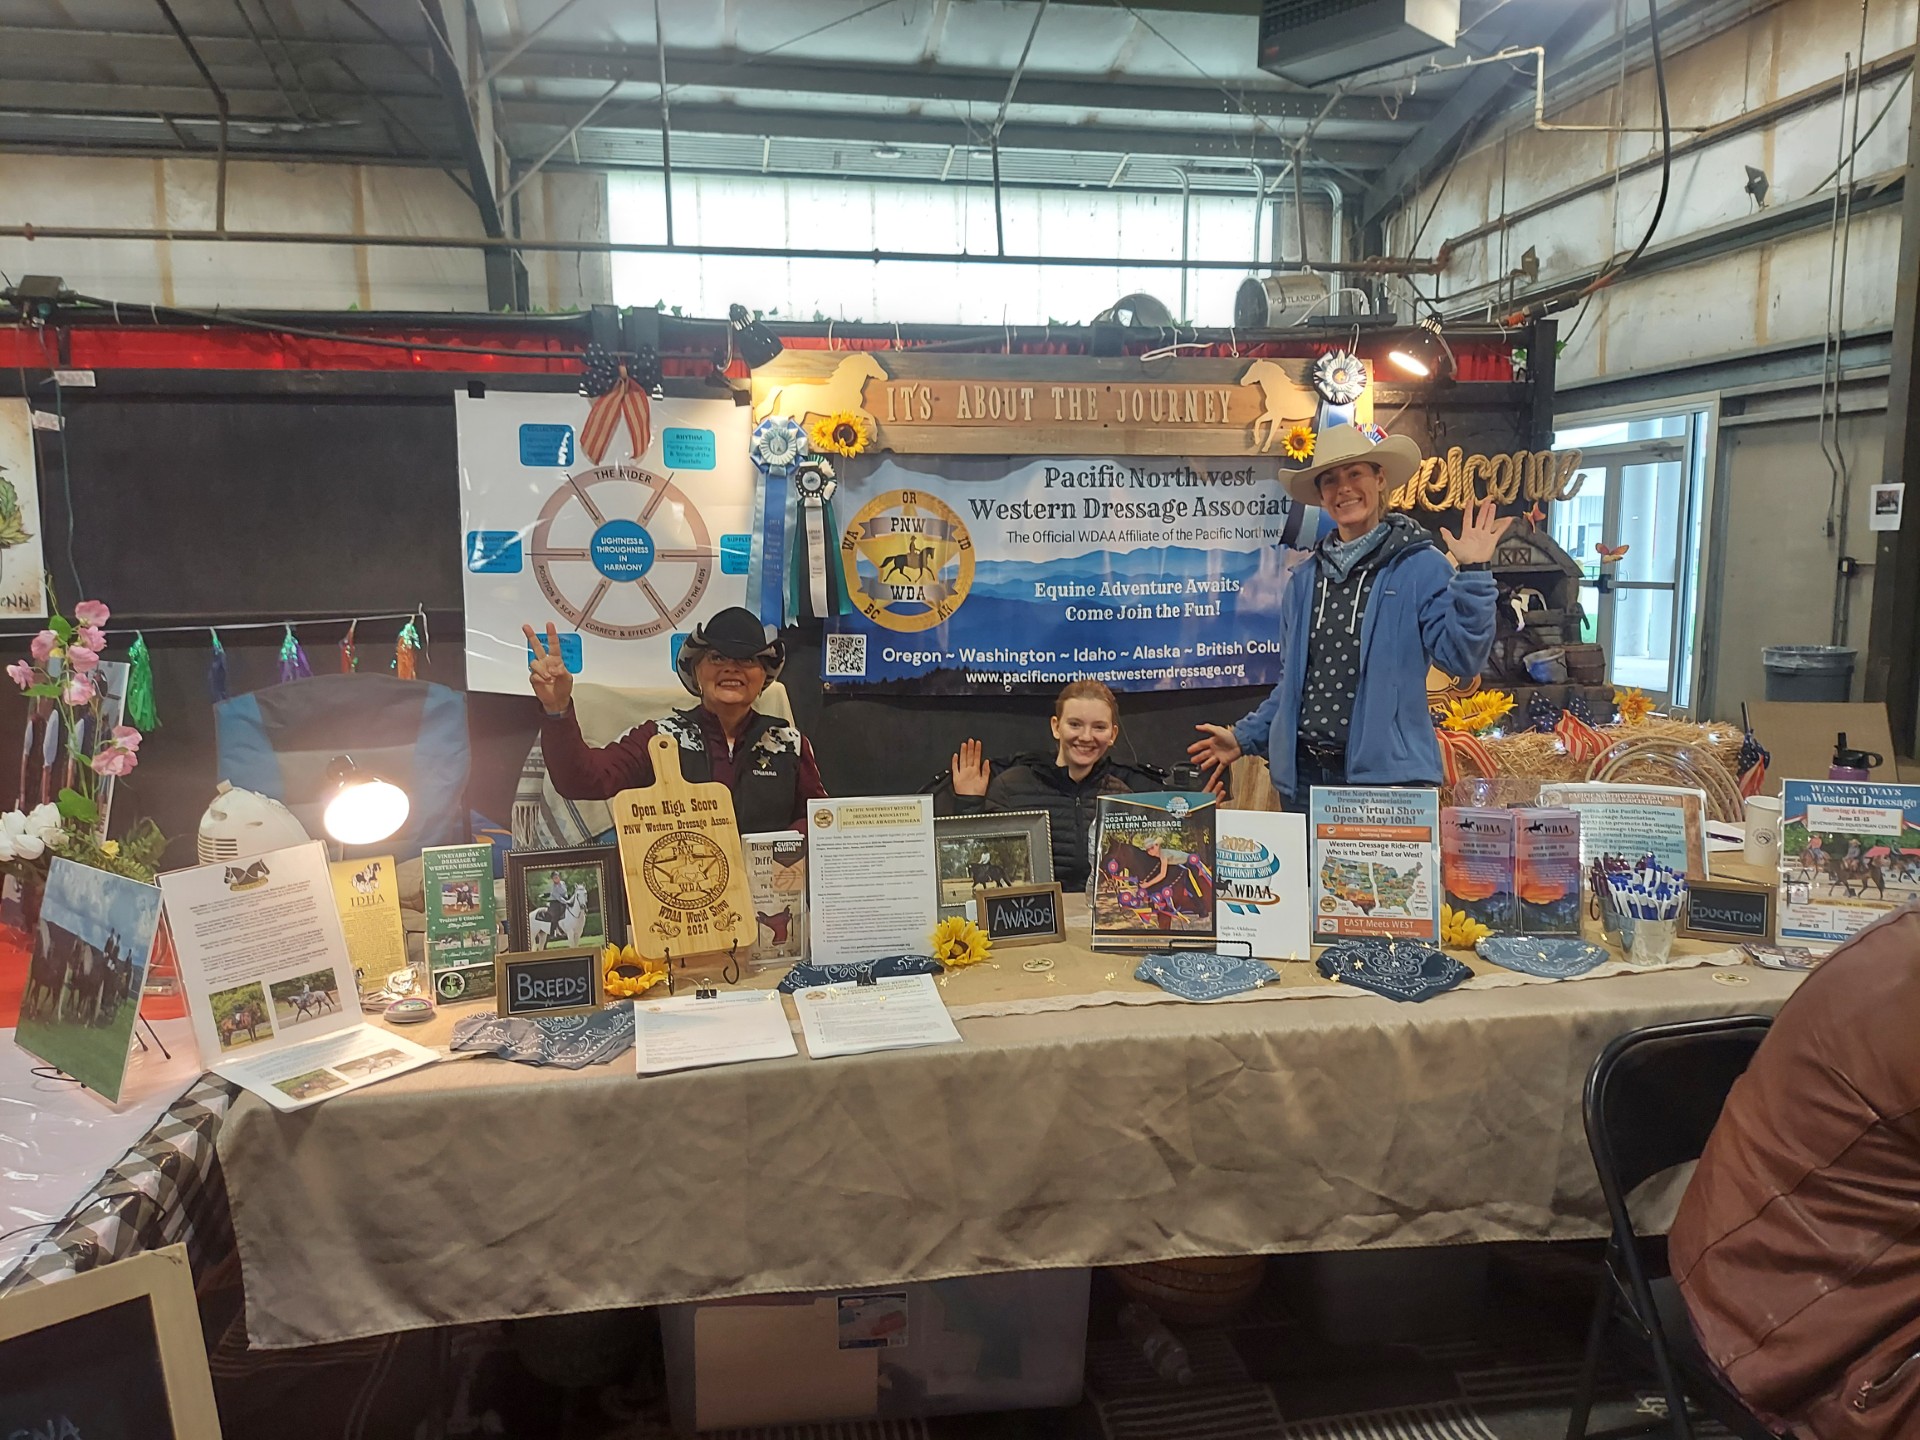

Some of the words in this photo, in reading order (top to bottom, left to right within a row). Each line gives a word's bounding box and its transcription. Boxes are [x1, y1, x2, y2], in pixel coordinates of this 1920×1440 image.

[887, 382, 932, 421] IT'S
[957, 385, 1034, 421] ABOUT
[1051, 386, 1098, 421] THE
[1116, 388, 1232, 423] JOURNEY
[594, 470, 614, 480] THE
[620, 470, 652, 484] RIDER
[1044, 465, 1125, 488] Pacific
[1129, 466, 1256, 488] Northwest
[902, 491, 917, 504] OR
[968, 498, 1077, 520] Western
[1083, 497, 1188, 524] Dressage
[1192, 493, 1290, 518] Associat
[891, 517, 926, 533] PNW
[601, 537, 638, 545] LIGHTNESS
[842, 530, 859, 551] WA
[1007, 531, 1030, 544] The
[1033, 529, 1075, 543] Official
[1078, 530, 1116, 543] WDAA
[1118, 529, 1160, 542] Affiliate
[1162, 528, 1175, 541] of
[1176, 528, 1193, 541] the
[1195, 526, 1232, 541] Pacific
[1235, 526, 1283, 539] Northwe
[596, 546, 649, 554] THROUGHNESS
[603, 563, 643, 571] HARMONY
[538, 565, 555, 597] POSITION
[674, 607, 686, 619] USE
[685, 597, 694, 608] OF
[691, 584, 701, 599] THE
[698, 567, 706, 585] AIDS
[890, 585, 926, 600] WDA
[1034, 581, 1096, 601] Equine
[1098, 580, 1183, 597] Adventure
[1185, 578, 1244, 595] Awaits,
[559, 603, 576, 619] SEAT
[864, 603, 880, 620] BC
[1065, 605, 1113, 621] Come
[1116, 604, 1152, 620] Join
[1156, 602, 1180, 619] the
[1184, 600, 1222, 618] Fun!
[585, 622, 617, 637] CORRECT
[627, 623, 663, 637] EFFECTIVE
[882, 647, 942, 666] Oregon
[958, 647, 1056, 666] Washington
[1073, 647, 1117, 662] Idaho
[1132, 645, 1180, 661] Alaska
[1196, 640, 1243, 657] British
[1246, 639, 1280, 654] Colu
[966, 663, 1245, 685] www.pacificnorthwestwesterndressage.org
[1352, 790, 1390, 798] Northwest
[1810, 784, 1866, 795] WINNING
[1869, 787, 1902, 796] WAYS
[1640, 794, 1675, 802] WESTERN
[1811, 792, 1862, 805] Western
[1862, 795, 1917, 809] Dressage
[631, 803, 657, 820] Open
[661, 800, 686, 817] High
[690, 798, 718, 812] Score
[1324, 805, 1357, 814] Online
[1359, 806, 1394, 815] Virtual
[1397, 806, 1425, 815] Show
[1642, 809, 1676, 817] Northwest
[623, 824, 642, 835] PNW
[645, 821, 674, 833] Western
[677, 818, 707, 830] Dressage
[711, 816, 732, 827] Assoc.
[1104, 821, 1140, 830] WESTERN
[1141, 820, 1182, 828] DRESSAGE
[1105, 815, 1123, 823] 2024
[1333, 814, 1364, 825] Opens
[1366, 815, 1389, 825] May
[1390, 816, 1416, 825] 10th!
[1475, 823, 1501, 833] WDAA
[1544, 824, 1570, 834] WDAA
[672, 845, 694, 855] PNW
[1222, 834, 1255, 852] 2024
[1358, 841, 1389, 849] Dressage
[1234, 851, 1262, 862] DRESSAGE
[458, 861, 488, 869] DRESSAGE
[1217, 866, 1257, 879] CHAMPIONSHIP
[1257, 866, 1273, 878] SHOW
[679, 882, 702, 893] WDA
[1234, 884, 1272, 899] WDAA
[350, 894, 386, 907] IDHA
[659, 905, 682, 923] WDAA
[686, 909, 709, 924] World
[709, 900, 730, 918] Show
[994, 904, 1051, 932] AWARDS
[1690, 899, 1762, 924] EDUCATION
[1344, 918, 1364, 927] EAST
[1366, 919, 1390, 928] Meets
[1391, 920, 1414, 929] WEST
[517, 973, 588, 1000] BREEDS
